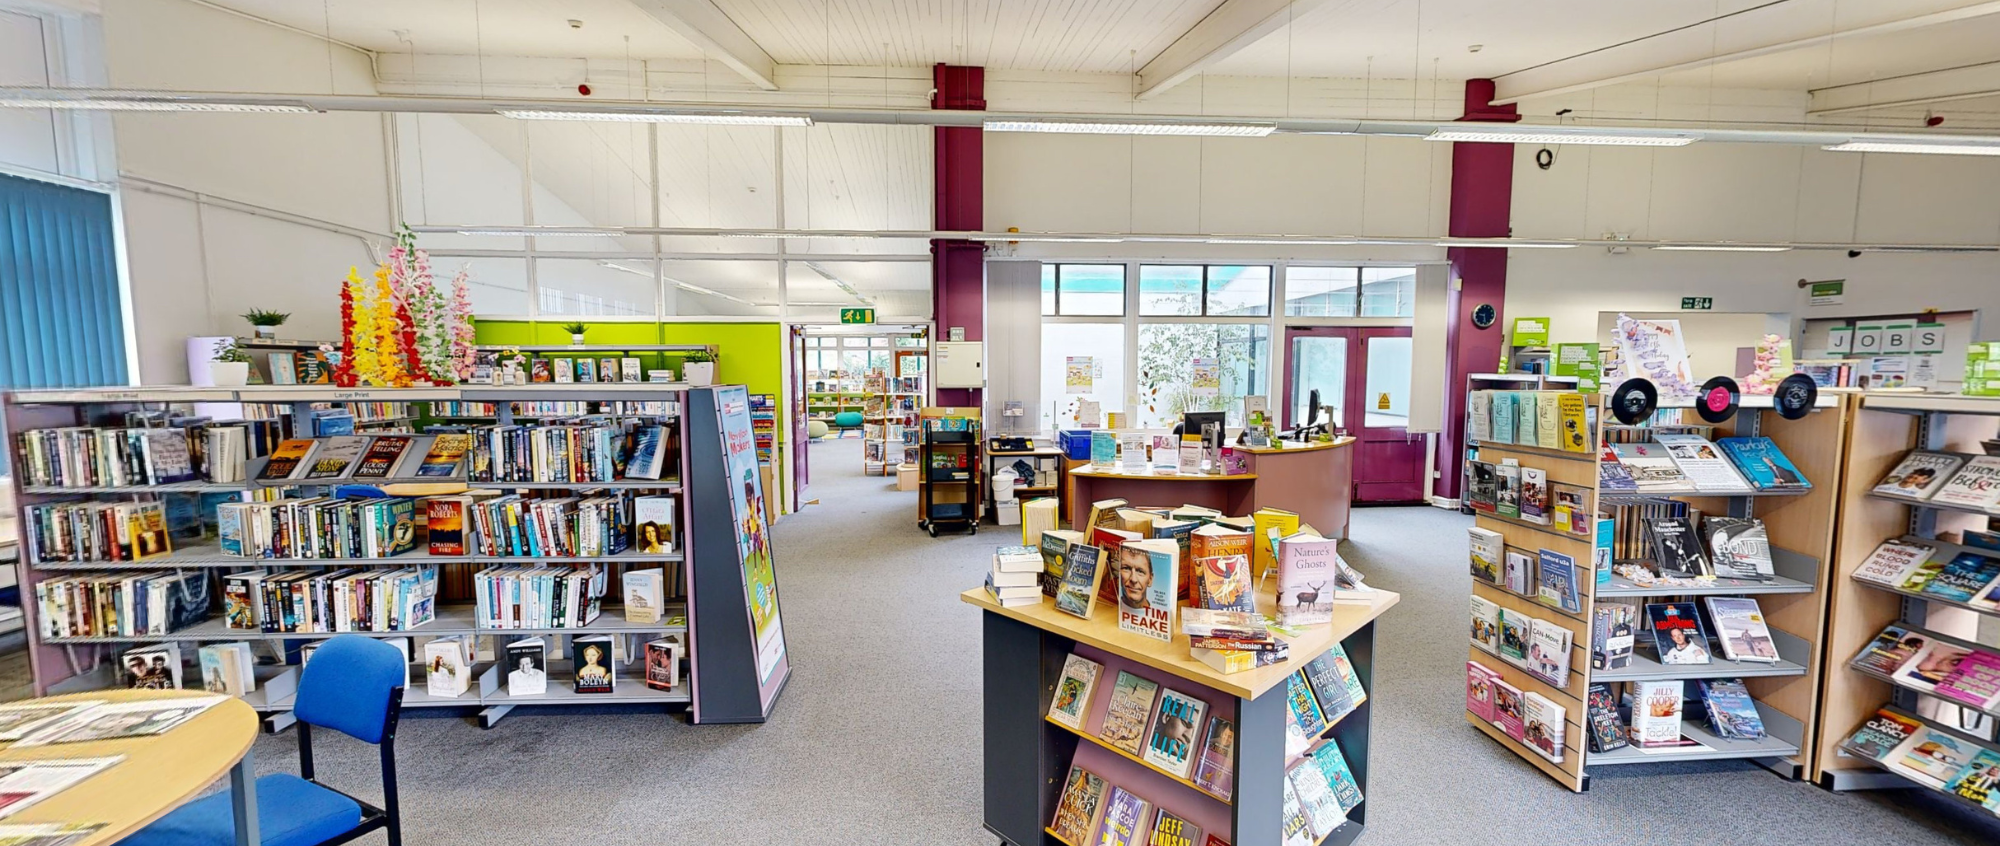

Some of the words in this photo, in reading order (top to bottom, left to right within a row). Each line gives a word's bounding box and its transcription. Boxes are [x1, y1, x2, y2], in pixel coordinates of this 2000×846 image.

[1834, 333, 1936, 347] JOBS
[1904, 460, 1945, 469] BROAD
[1909, 455, 1953, 465] STUART
[1042, 539, 1065, 553] McDermid
[1208, 548, 1246, 556] HENRY
[1294, 545, 1330, 557] Nature's
[1722, 540, 1759, 554] BOND
[1882, 547, 1918, 559] WHERE
[1069, 552, 1095, 565] Griffiths
[1295, 559, 1327, 570] Ghosts
[1872, 560, 1900, 571] RUNS
[1875, 553, 1911, 565] BLOOD
[1865, 566, 1893, 577] COLD
[1954, 568, 1977, 580] THE
[1936, 573, 1986, 589] SQUARE
[1143, 606, 1168, 622] TIM
[1122, 611, 1168, 634] PEAKE
[1655, 619, 1697, 630] ARMSTRONG
[1121, 623, 1169, 640] LIMITLESS
[1532, 627, 1560, 645] CAN-Move
[1235, 642, 1262, 650] Russian
[1313, 659, 1326, 672] THE
[1311, 666, 1339, 688] PERFECT
[1322, 684, 1339, 698] GIRL
[1653, 687, 1675, 696] JILLY
[1117, 693, 1142, 711] Claire
[1646, 695, 1680, 706] COOPER
[1111, 700, 1143, 721] Keegan
[1162, 694, 1196, 724] REAL
[1593, 712, 1619, 721] SKELETON
[1866, 720, 1909, 738] CLANCY
[1879, 718, 1905, 731] TOM
[1645, 726, 1678, 738] Tackle!
[1151, 732, 1187, 763] LIFE
[1613, 740, 1626, 748] KELLY
[1864, 733, 1895, 748] GRADE
[1067, 785, 1095, 806] AMANDA
[1064, 792, 1094, 815] QUICK
[1114, 800, 1132, 816] SARA
[1060, 809, 1075, 821] WHEN
[1076, 817, 1088, 828] SHE
[1107, 807, 1135, 828] PASCOE
[1059, 819, 1083, 836] DREAMS
[1104, 816, 1131, 837] weirdo
[1159, 816, 1183, 836] JEFF
[1150, 829, 1191, 846] LINDSAY
